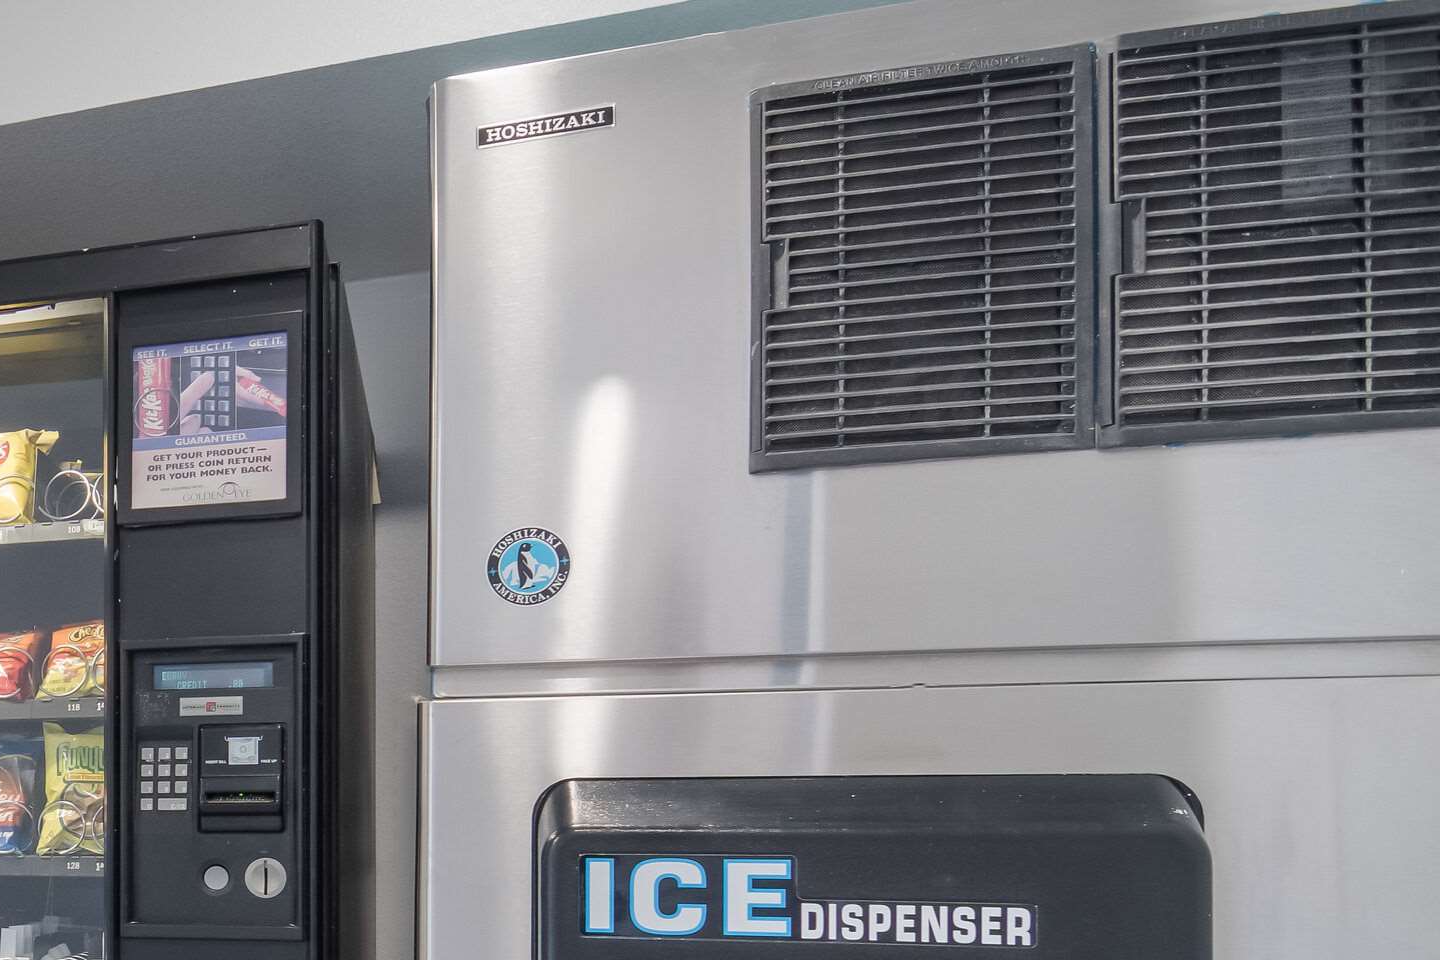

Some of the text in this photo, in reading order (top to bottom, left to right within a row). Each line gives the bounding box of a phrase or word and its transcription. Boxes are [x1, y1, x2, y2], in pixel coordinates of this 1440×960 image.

[486, 110, 606, 143] HOSHIZAKI
[183, 343, 220, 354] SELECT
[248, 338, 269, 347] GET
[148, 455, 272, 472] OR PRESS COIN RETURN
[153, 453, 171, 462] GET
[175, 451, 203, 460] YOUR
[146, 465, 273, 482] FOR YOUR MONEY BACK.
[492, 528, 562, 559] HOSHIZAKI
[176, 680, 208, 689] CREDIT
[584, 856, 1033, 947] ICE DISPENSER
